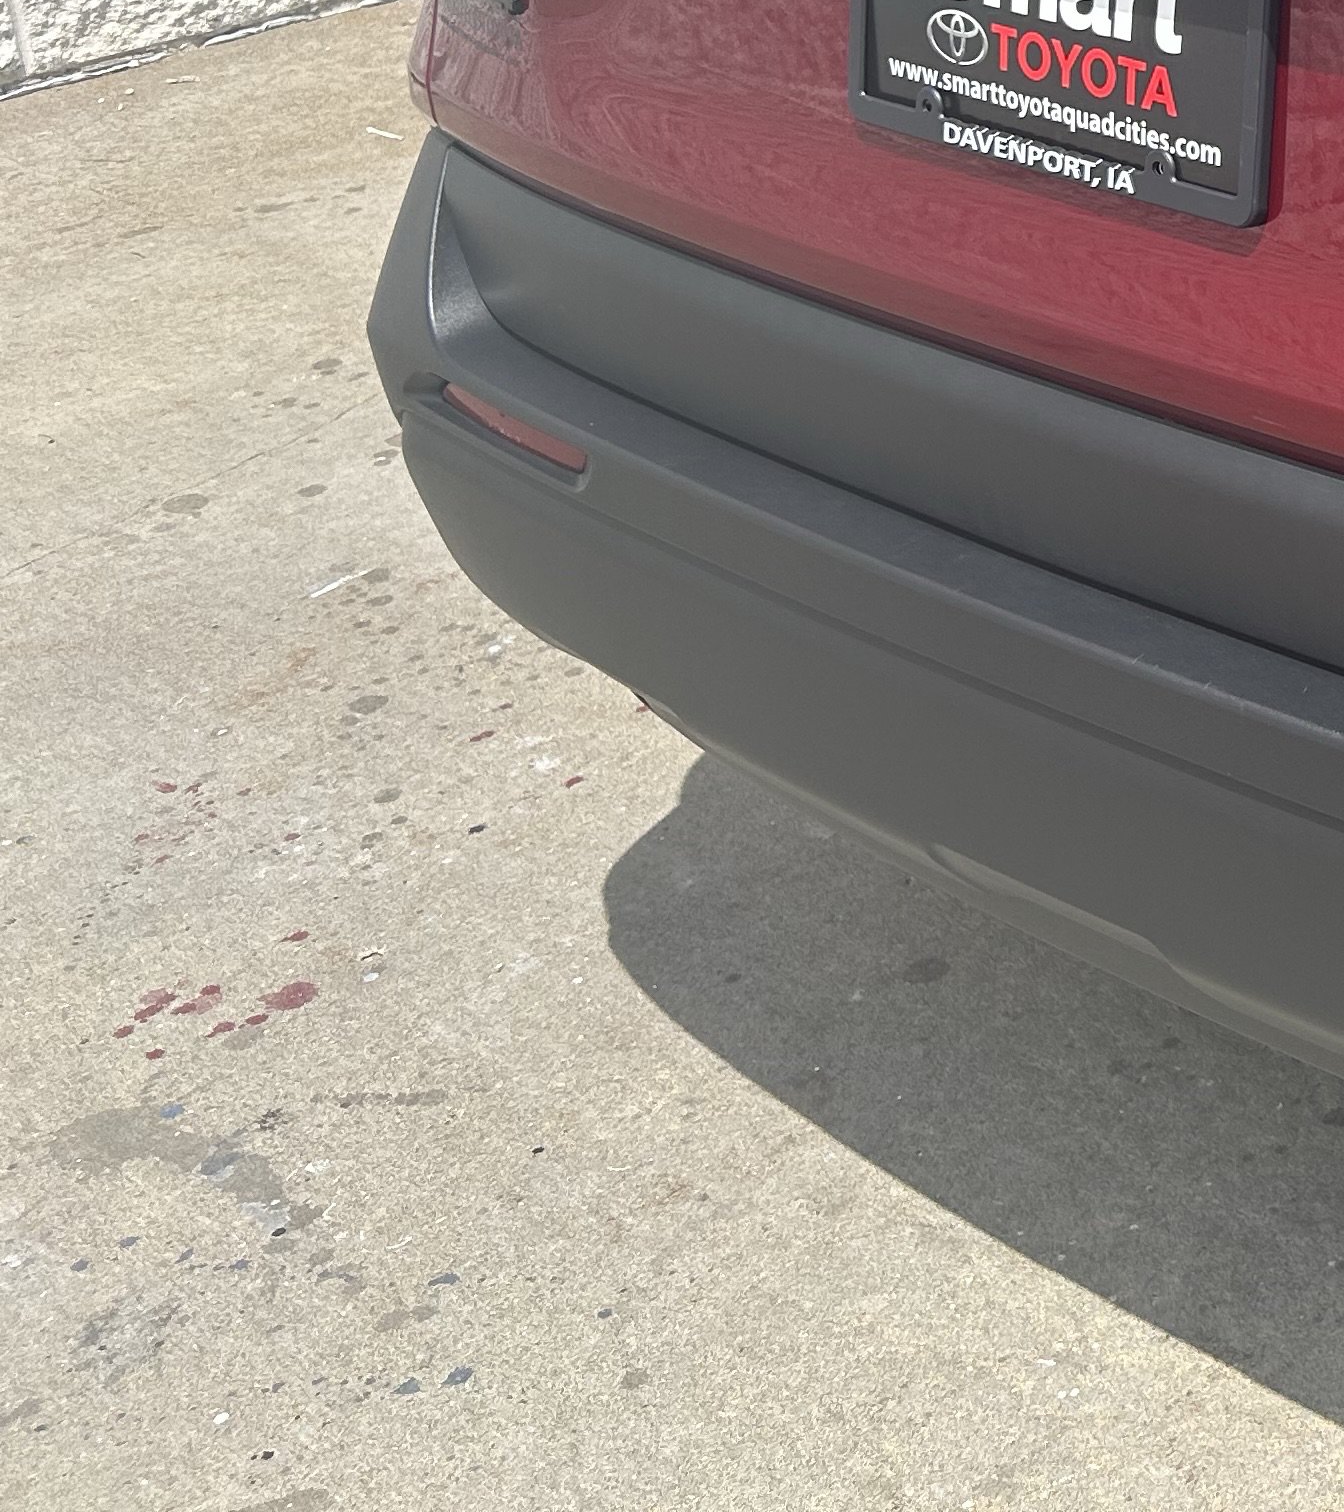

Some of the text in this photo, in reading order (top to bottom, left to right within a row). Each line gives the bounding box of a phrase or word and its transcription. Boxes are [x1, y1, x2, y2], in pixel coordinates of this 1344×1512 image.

[888, 57, 1222, 167] www.smarttoyotaquadcities.com
[990, 23, 1178, 117] TOYOTA
[943, 120, 1135, 194] DAVENPORT, IA
